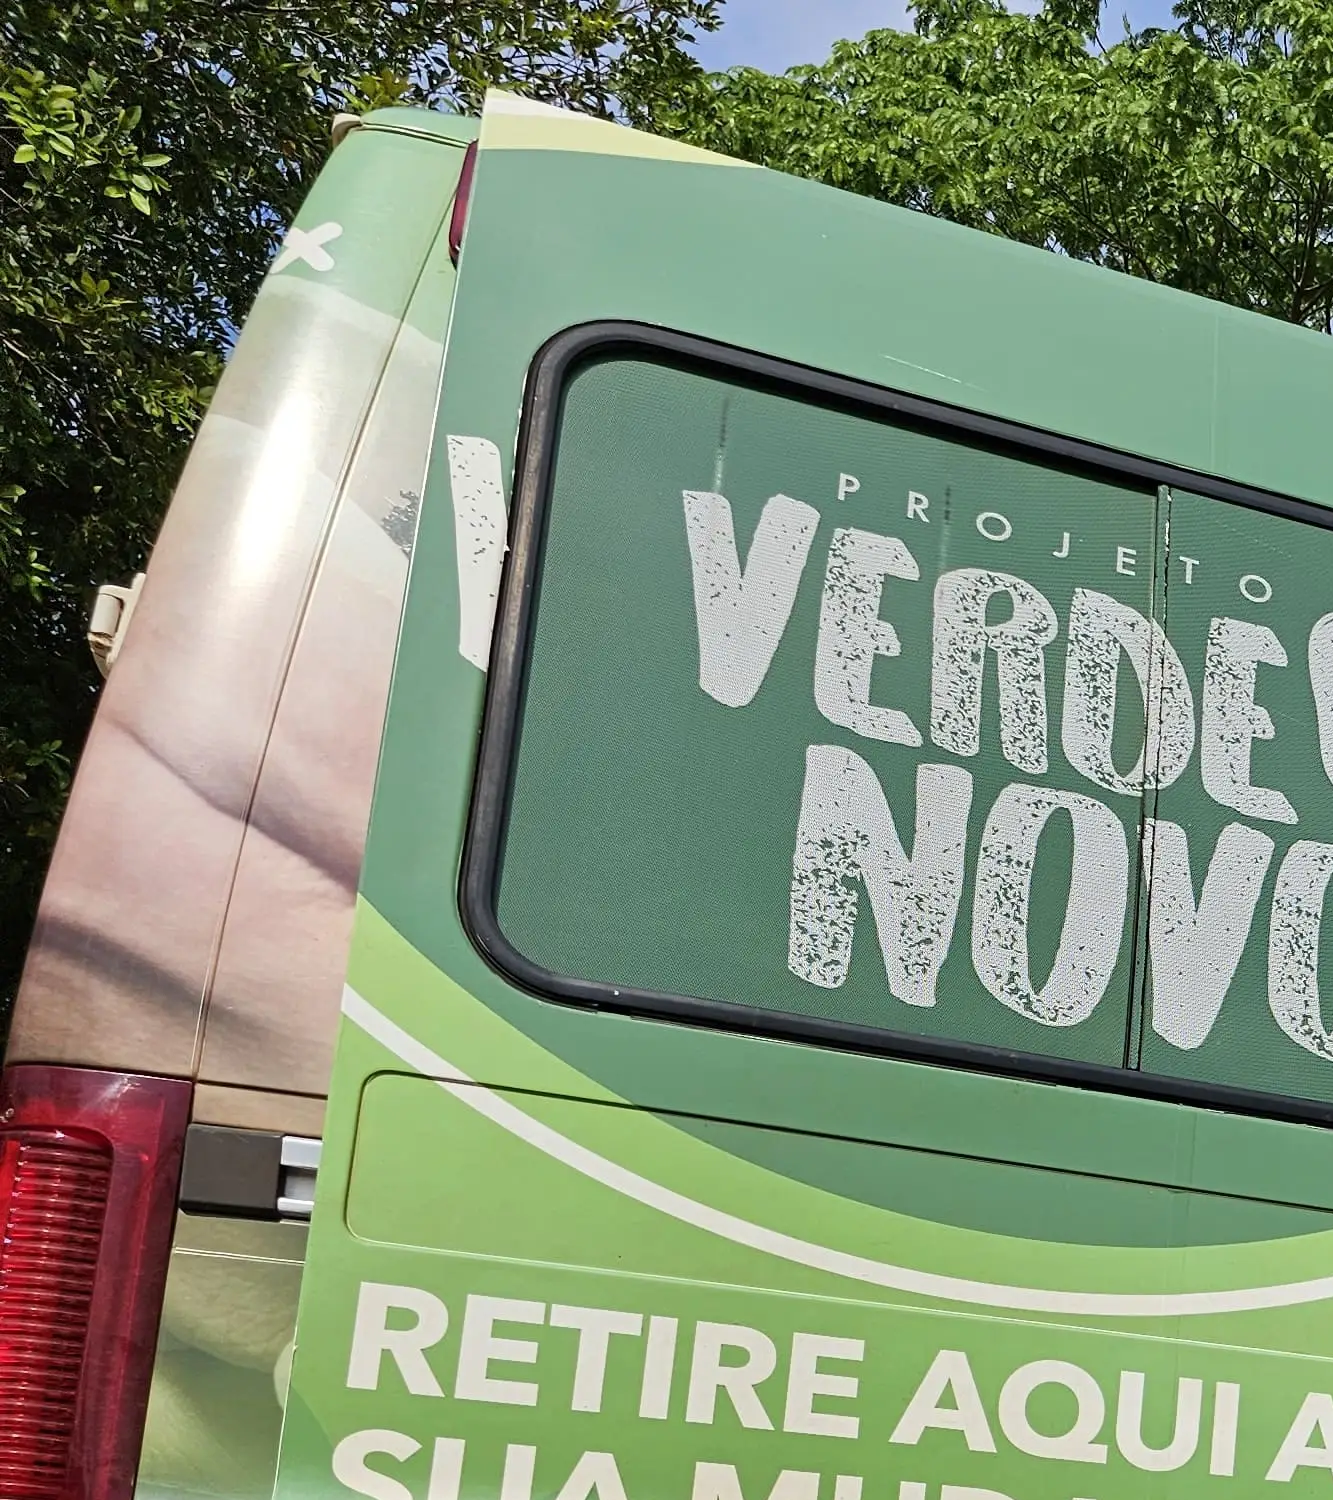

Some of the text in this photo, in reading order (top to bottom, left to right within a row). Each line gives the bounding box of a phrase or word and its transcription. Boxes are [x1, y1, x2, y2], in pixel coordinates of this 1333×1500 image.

[836, 472, 1274, 602] PROJETO
[682, 488, 1298, 824] VERDE
[345, 1281, 867, 1441] RETIRE
[888, 1349, 1236, 1479] AQUI
